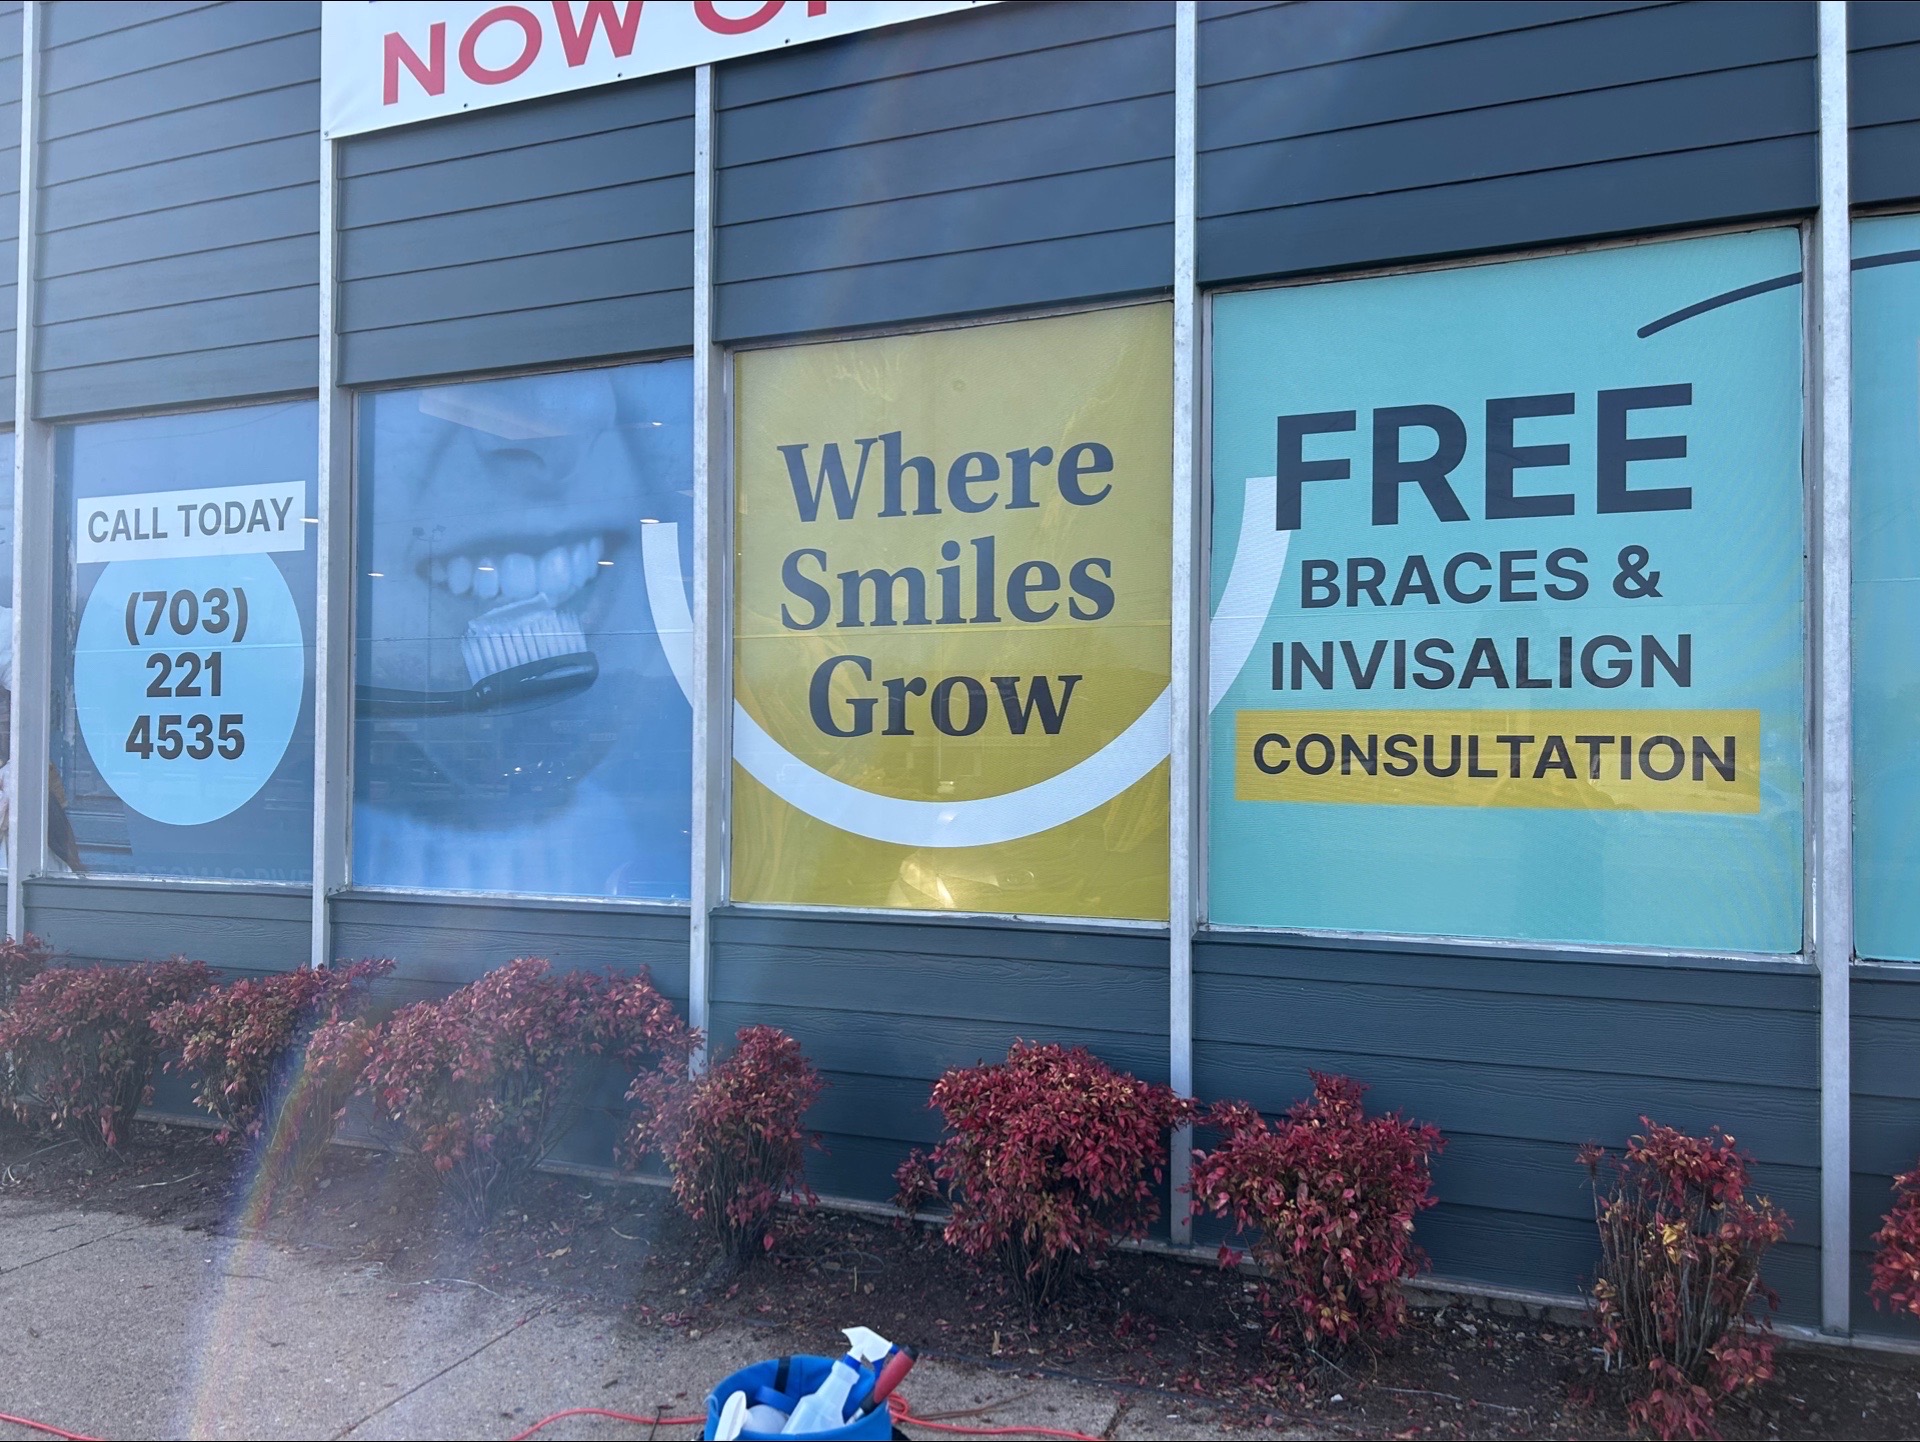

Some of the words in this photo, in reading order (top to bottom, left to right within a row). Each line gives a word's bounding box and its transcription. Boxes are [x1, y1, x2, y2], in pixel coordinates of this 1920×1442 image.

[383, 1, 644, 106] NOW
[777, 431, 1114, 522] Where
[1275, 382, 1693, 531] FREE
[88, 507, 168, 543] CALL
[178, 497, 294, 537] TODAY
[781, 535, 1115, 630] Smiles
[1300, 548, 1590, 609] BRACES
[1612, 545, 1663, 598] &
[125, 588, 248, 646] (703)
[146, 651, 222, 698] 221
[1271, 633, 1692, 690] INVISALIGN
[808, 655, 1083, 737] Grow
[125, 713, 244, 760] 4535
[1253, 732, 1736, 782] CONSULTATION
